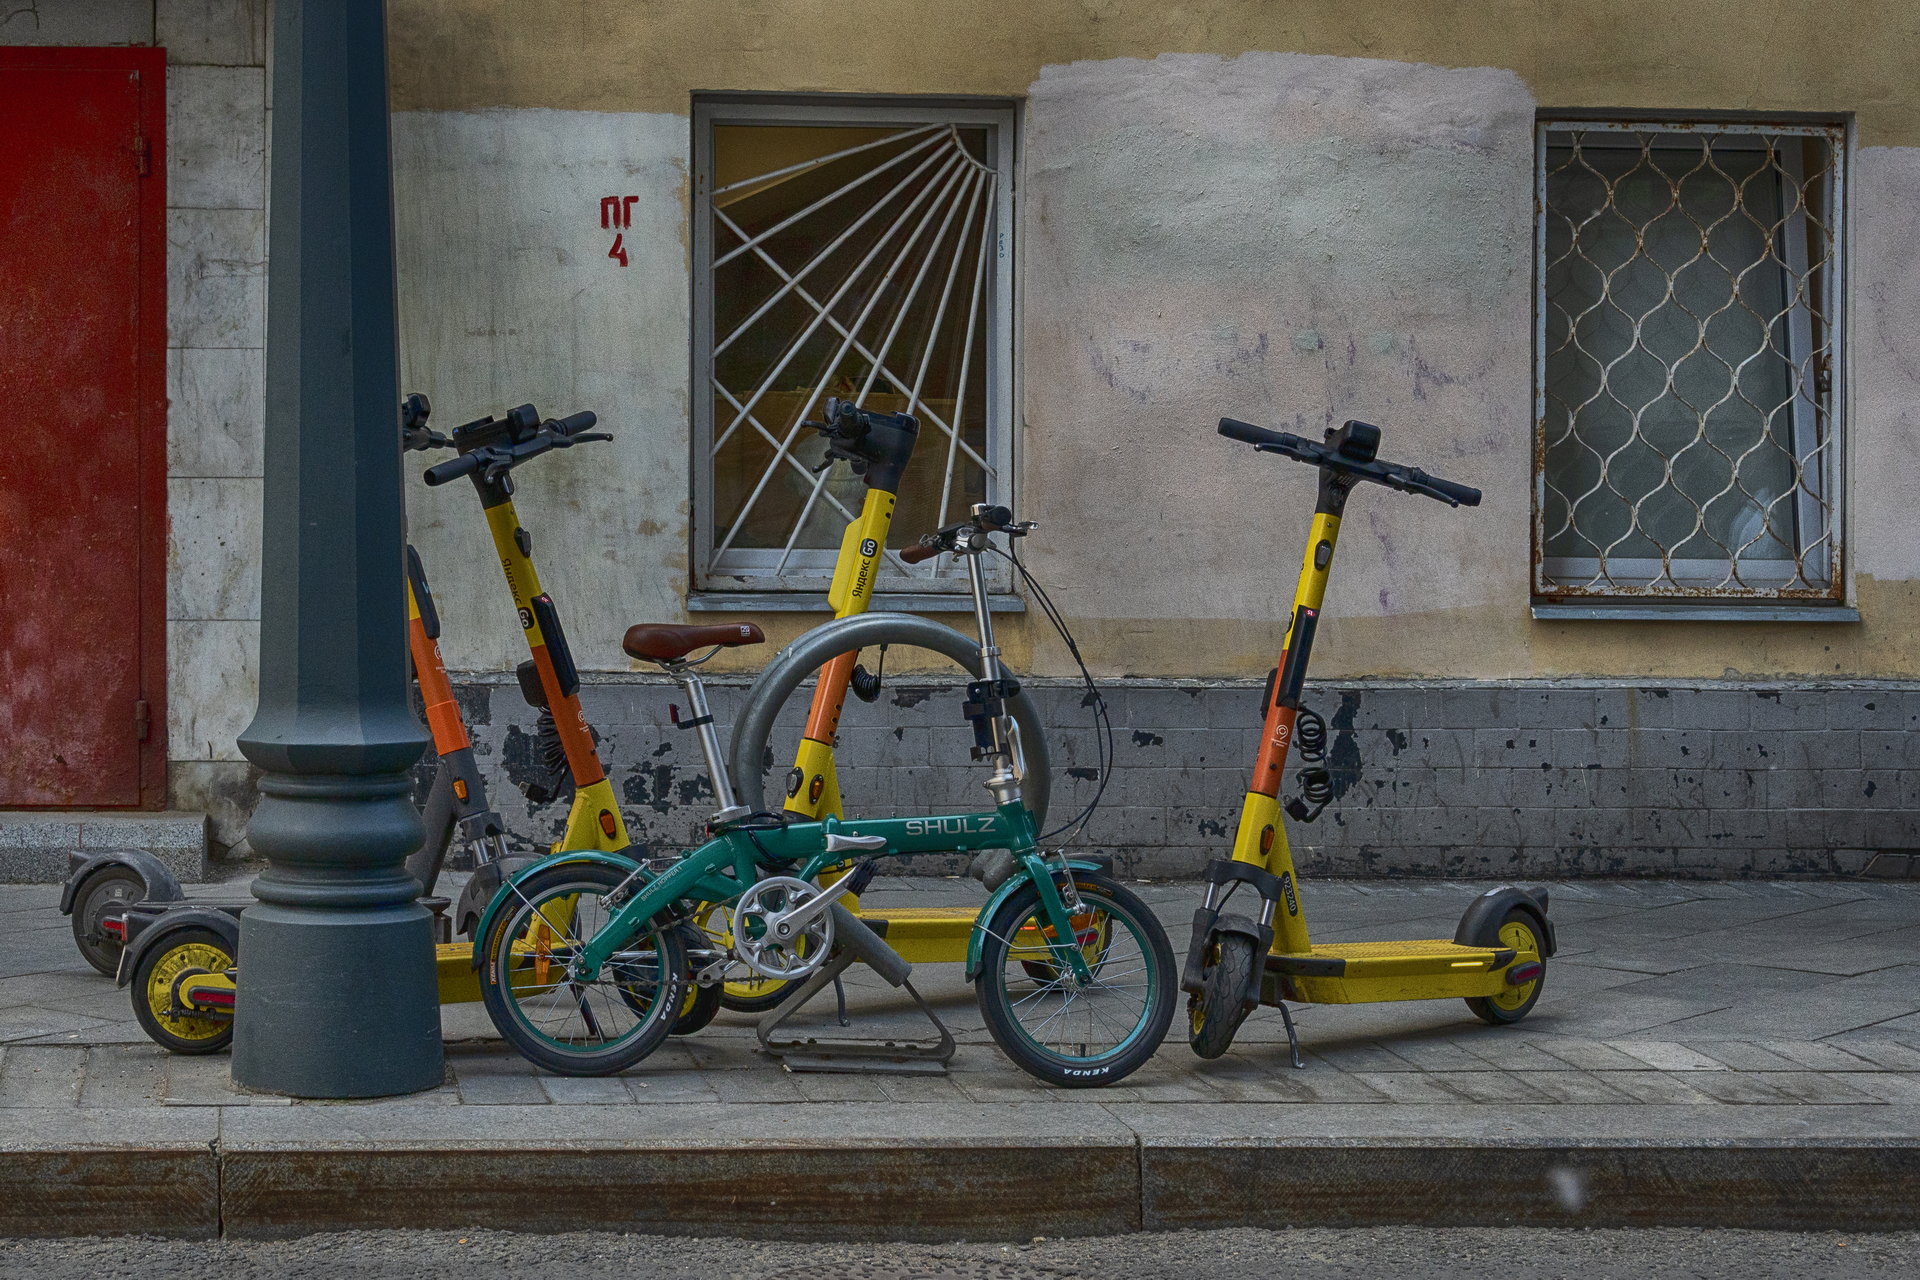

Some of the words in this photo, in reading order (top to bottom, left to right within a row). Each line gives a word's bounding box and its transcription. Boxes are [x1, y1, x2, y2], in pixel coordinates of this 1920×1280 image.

[600, 195, 640, 230] ПГ
[608, 233, 629, 268] 4
[852, 558, 871, 599] Яндекс
[862, 540, 876, 556] Go
[500, 558, 523, 606] Яндекс
[518, 608, 530, 628] Go
[905, 817, 997, 836] SHULZ
[1283, 875, 1297, 912] 923240
[660, 972, 679, 1021] KENDA
[1063, 1066, 1110, 1077] KENDA
